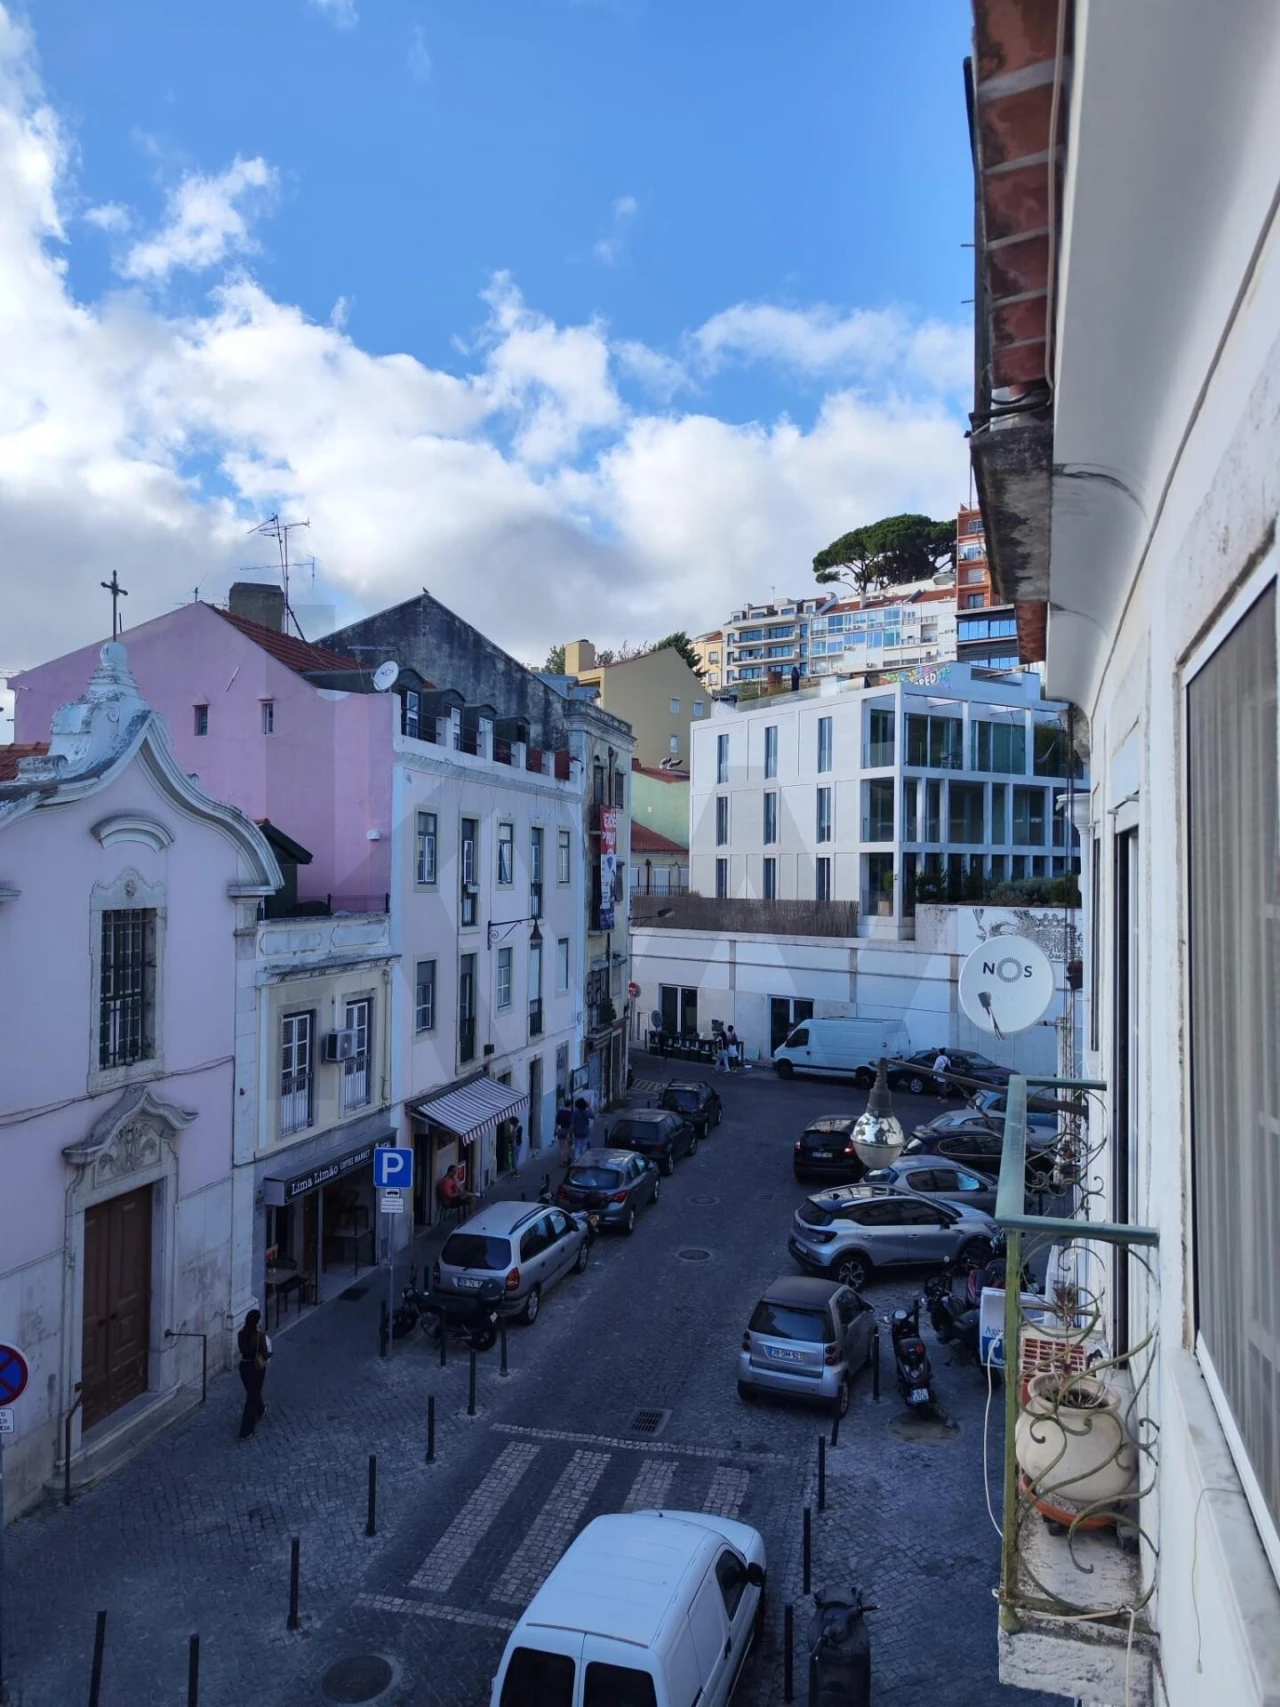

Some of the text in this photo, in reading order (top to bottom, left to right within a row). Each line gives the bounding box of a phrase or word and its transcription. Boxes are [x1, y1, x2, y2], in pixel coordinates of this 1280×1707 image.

[982, 957, 1033, 984] NOS
[292, 1149, 371, 1195] Lima Limão COFFEE MARKET
[382, 1152, 404, 1184] P
